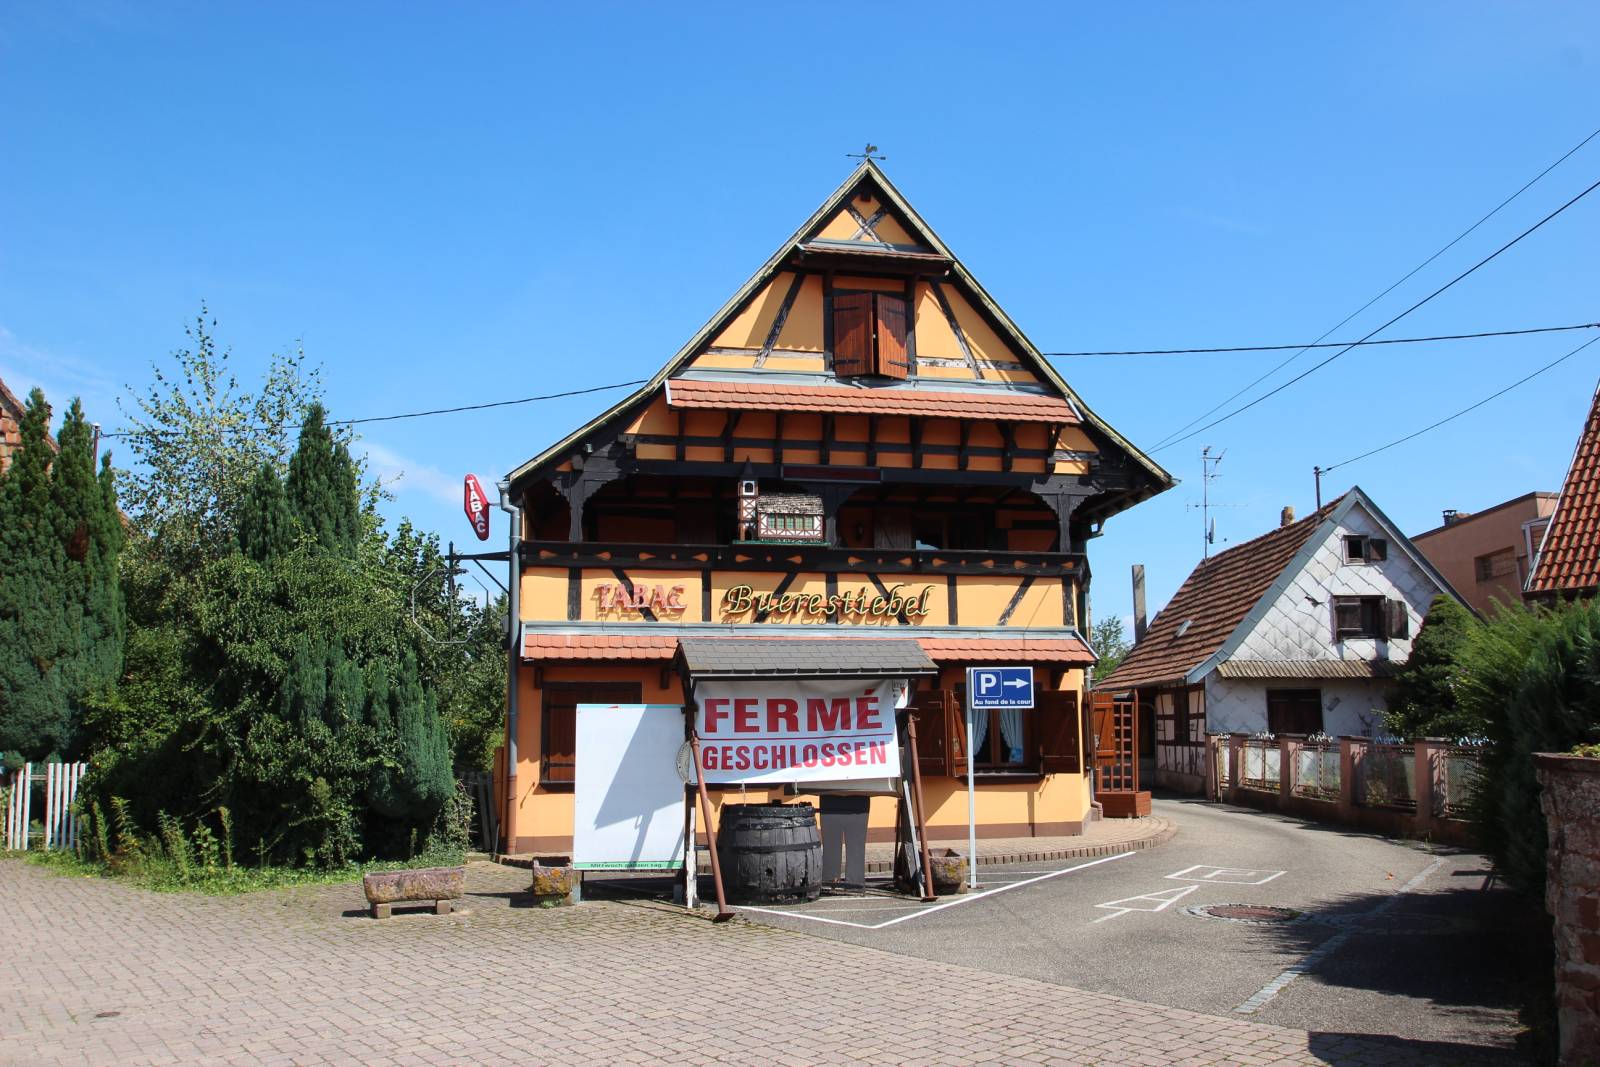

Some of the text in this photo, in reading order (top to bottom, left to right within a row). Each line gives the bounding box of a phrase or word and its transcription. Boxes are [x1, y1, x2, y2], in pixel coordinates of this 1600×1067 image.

[466, 479, 486, 533] TABAC
[597, 583, 687, 609] TABAC
[727, 584, 935, 617] Buerestiebel
[980, 673, 997, 695] P
[703, 688, 883, 733] FERMÉ
[702, 740, 887, 771] GESCHLOSSEN
